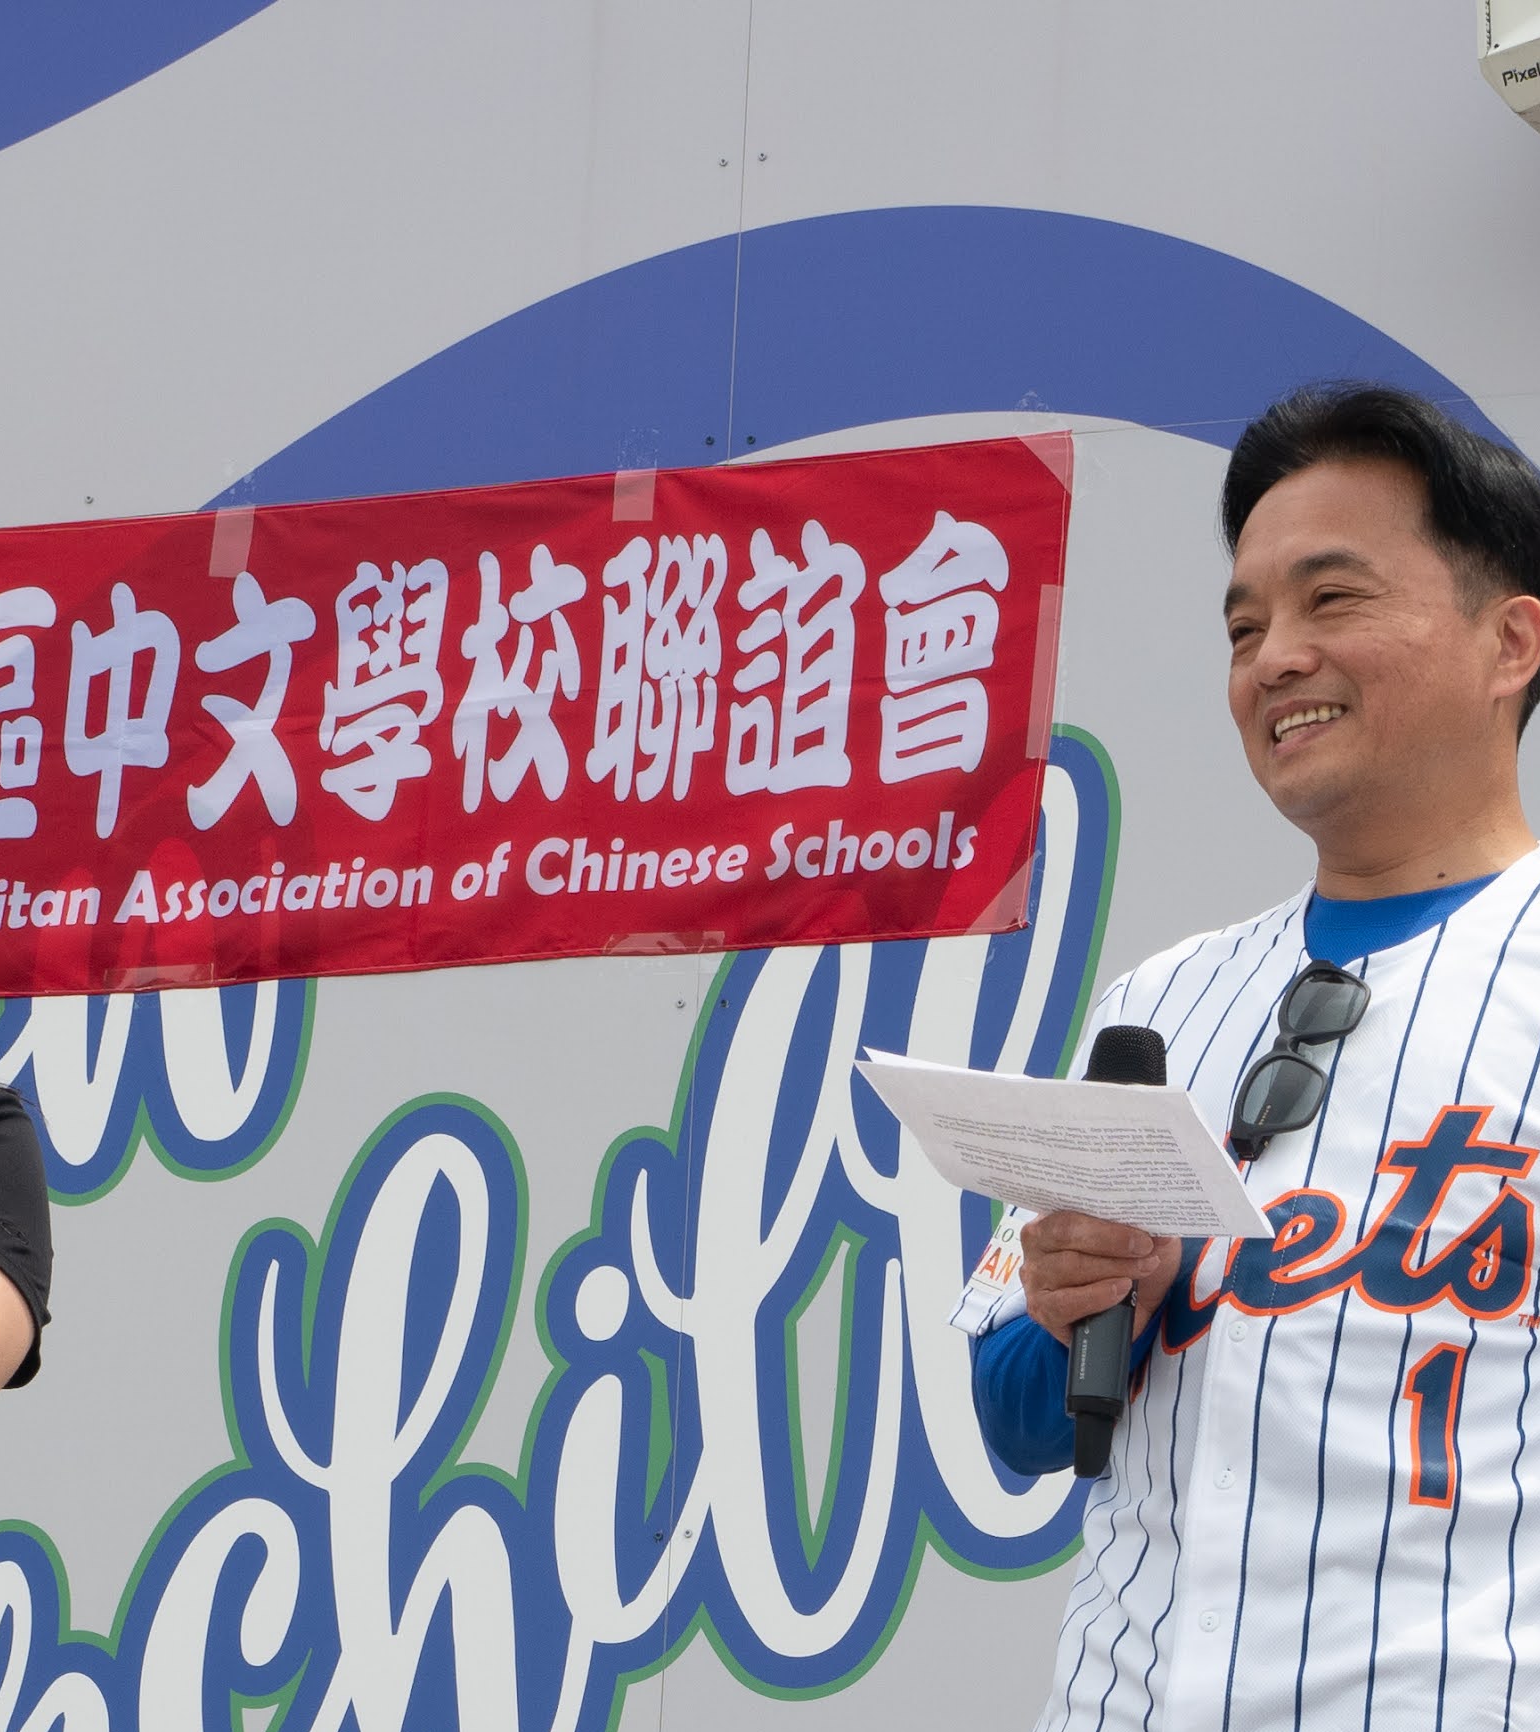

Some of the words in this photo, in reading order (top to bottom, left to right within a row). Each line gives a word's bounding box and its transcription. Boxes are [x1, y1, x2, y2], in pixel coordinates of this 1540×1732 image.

[113, 856, 434, 924] Association
[450, 841, 513, 901] of
[525, 837, 750, 895] Chinese
[764, 811, 979, 882] Schools
[974, 1243, 1021, 1285] AN
[1403, 1341, 1467, 1510] 1
